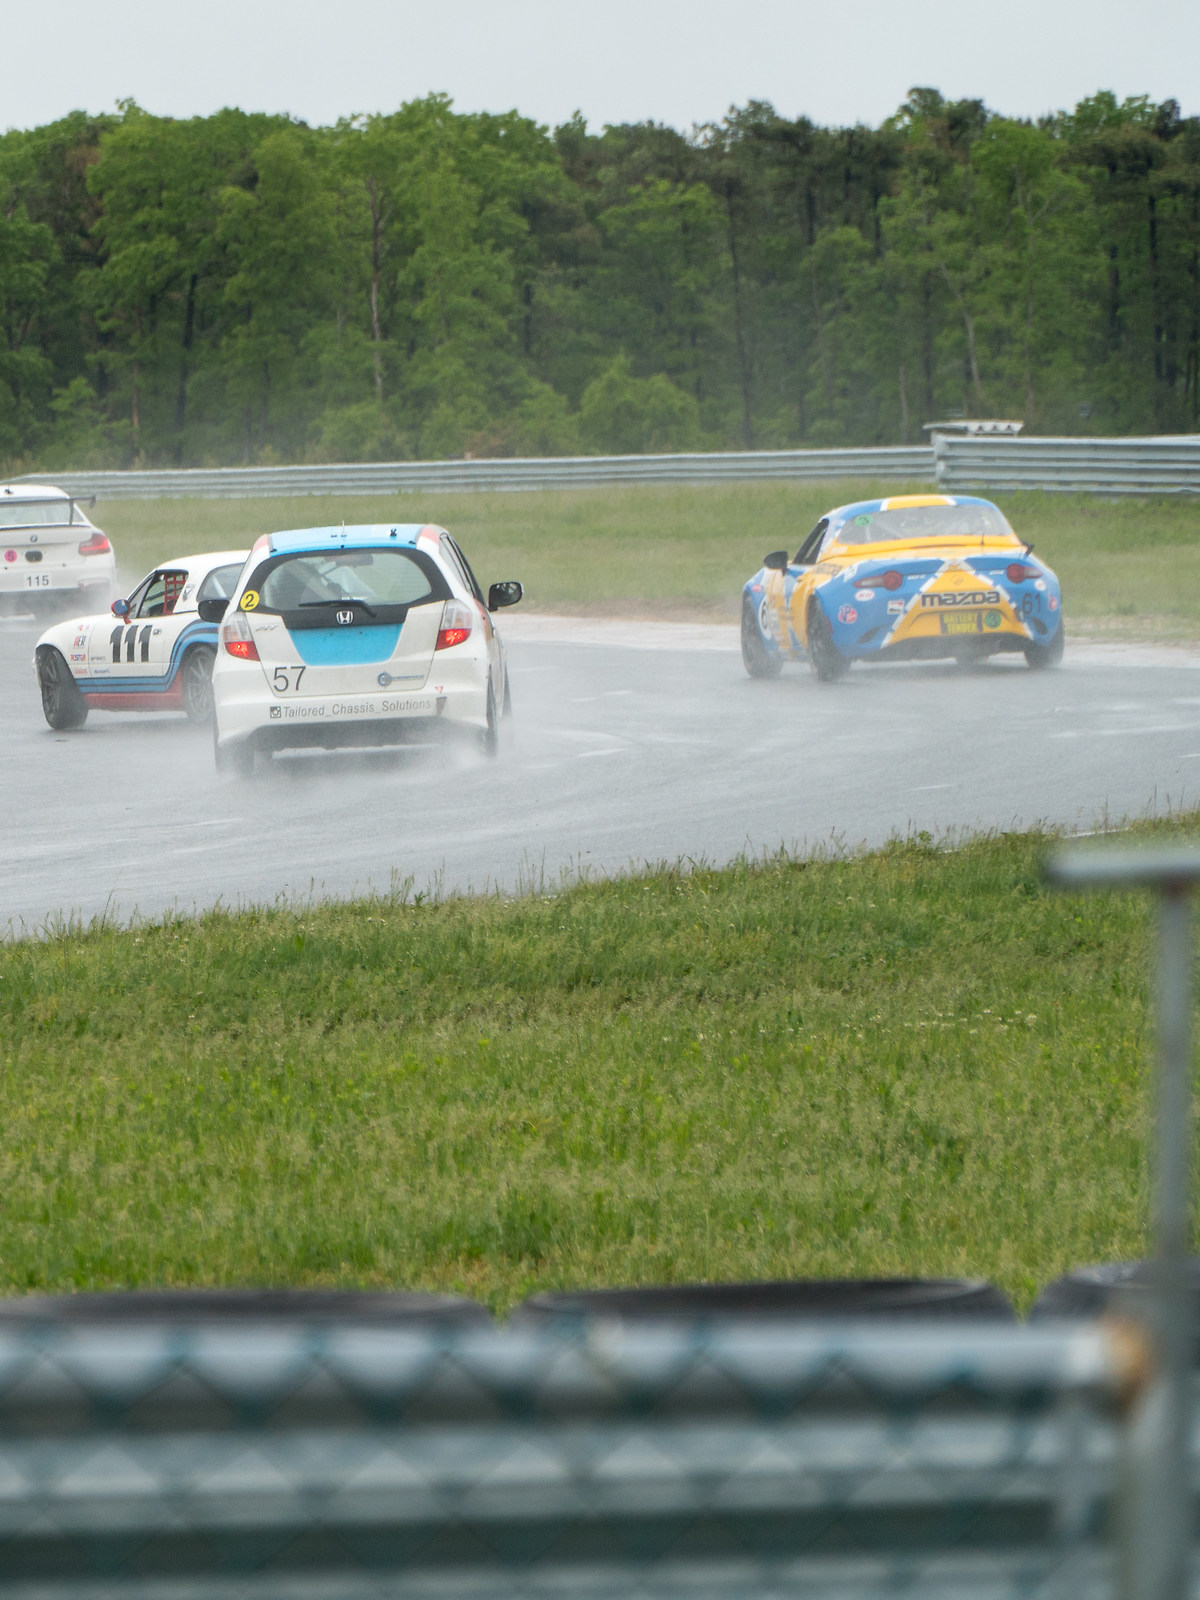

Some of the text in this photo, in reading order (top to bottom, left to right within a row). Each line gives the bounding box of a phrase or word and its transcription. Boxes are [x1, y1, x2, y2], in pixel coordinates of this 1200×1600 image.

[26, 574, 50, 588] 115
[245, 593, 255, 608] 2
[1021, 592, 1041, 615] 61
[109, 624, 153, 664] 111
[273, 665, 307, 692] 57
